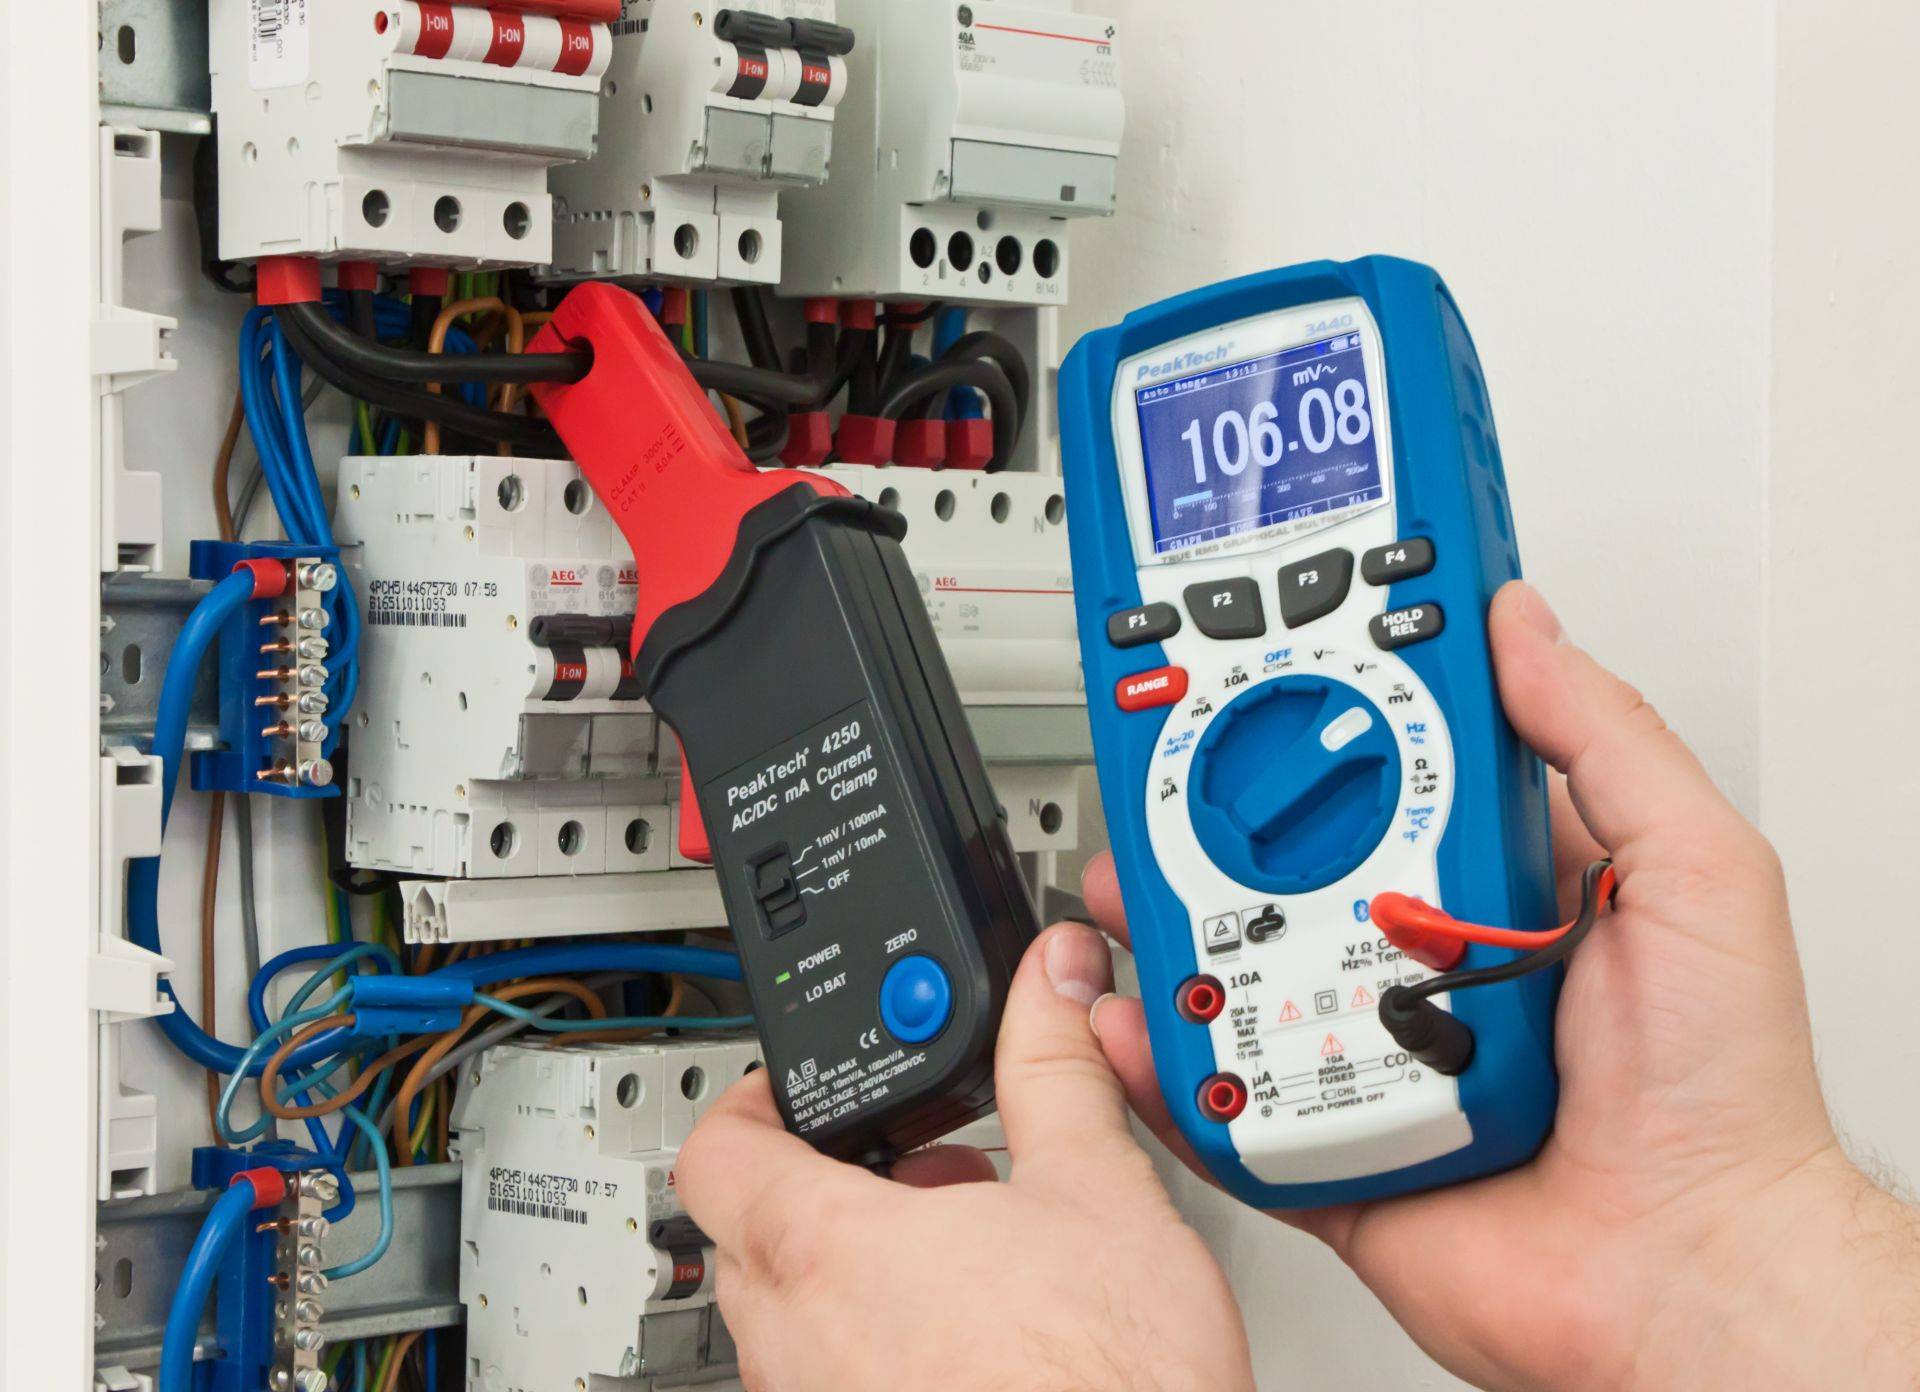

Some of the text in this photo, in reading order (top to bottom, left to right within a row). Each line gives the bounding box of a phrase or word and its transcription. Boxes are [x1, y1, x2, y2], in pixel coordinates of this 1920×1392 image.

[922, 274, 929, 286] 2
[959, 275, 967, 288] 4
[1007, 279, 1015, 292] 6
[1305, 313, 1353, 338] 3440
[1143, 386, 1169, 400] Auto
[1174, 377, 1208, 392] Range
[1181, 378, 1371, 484] 106.08
[610, 463, 639, 500] CLAMP
[621, 489, 639, 512] CAT
[1033, 516, 1045, 533] N
[1385, 549, 1407, 565] F4
[550, 570, 576, 581] AEG
[935, 576, 957, 586] AEG
[1297, 570, 1319, 587] F3
[464, 581, 498, 598] 07:58
[1212, 592, 1233, 608] F2
[1128, 614, 1148, 629] F1
[1381, 607, 1424, 628] HOLD
[1389, 622, 1419, 638] REL
[1263, 648, 1292, 663] OFF
[1126, 675, 1169, 697] RANGE
[1224, 672, 1249, 688] 10A
[1387, 691, 1414, 704] mV
[1191, 703, 1213, 718] mA
[1406, 722, 1427, 735] Hz
[821, 721, 861, 754] 4250
[731, 744, 873, 832] AC/DC mA Current
[830, 767, 878, 801] Clamp
[1414, 784, 1437, 795] CAP
[1029, 798, 1040, 817] N
[1404, 806, 1435, 817] Temp
[815, 826, 840, 849] 1mV
[848, 804, 887, 831] 100mA
[821, 848, 846, 869] 1mV
[854, 828, 887, 852] 10mA
[827, 869, 851, 890] OFF
[884, 928, 918, 953] ZERO
[1345, 944, 1356, 956] V
[1376, 950, 1409, 963] Tem
[797, 943, 842, 974] POWER
[805, 972, 847, 1003] LO BAT
[1229, 971, 1262, 989] 10A
[1247, 1005, 1258, 1015] for
[1232, 1017, 1258, 1029] 30 sec
[859, 1027, 880, 1049] CE
[1237, 1026, 1256, 1038] MAX
[1237, 1038, 1260, 1050] every
[1236, 1048, 1264, 1061] 15 min
[1325, 1054, 1345, 1065] 10A
[787, 1057, 858, 1098] INPUT: 60A MAX
[1318, 1062, 1355, 1077] 800mA
[791, 1085, 829, 1109] OUTPUT:
[867, 1049, 905, 1073] 100mV/A
[1318, 1071, 1356, 1086] FUSED
[794, 1052, 927, 1122] MAX VOLTAGE: 240VAC/300VDC
[871, 1085, 890, 1100] 60A
[1254, 1086, 1281, 1102] mA
[1337, 1086, 1357, 1097] CHG
[1297, 1092, 1386, 1117] AUTO POWER OFF
[584, 1180, 618, 1199] 07:57
